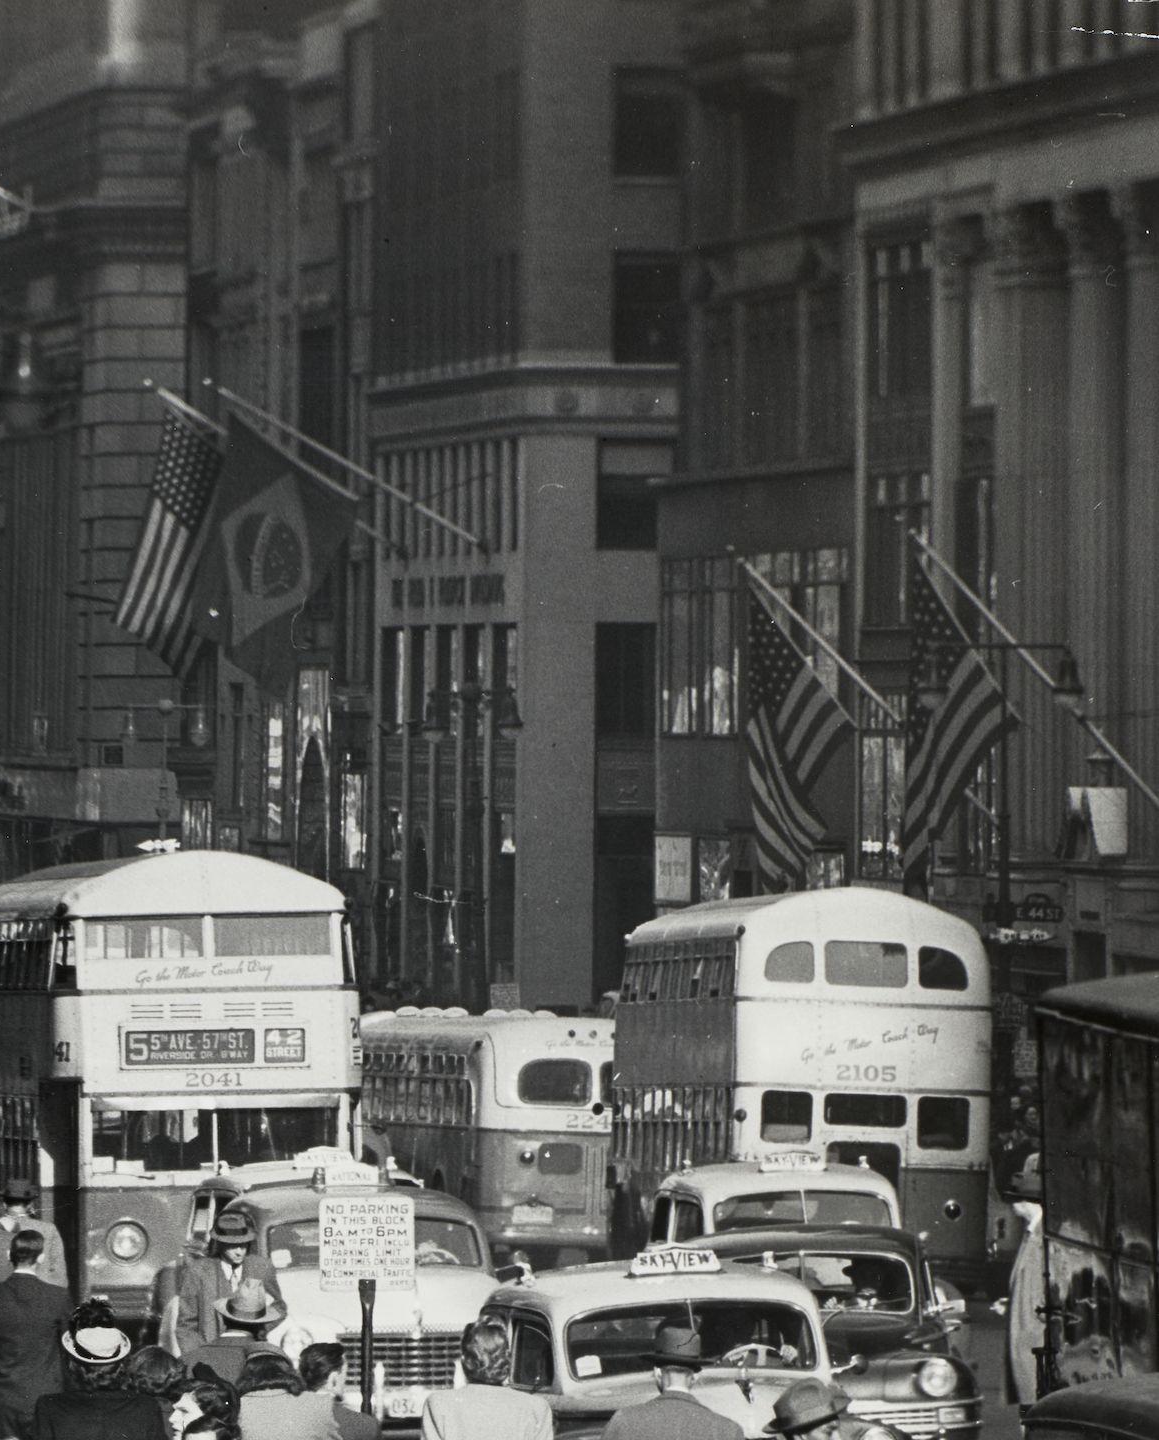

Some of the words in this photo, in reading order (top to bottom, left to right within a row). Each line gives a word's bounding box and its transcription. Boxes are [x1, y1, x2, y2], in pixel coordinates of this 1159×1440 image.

[1028, 907, 1044, 918] 44
[135, 969, 152, 988] Go
[155, 967, 170, 981] the
[172, 965, 207, 979] Motor
[211, 961, 243, 976] Coach
[247, 960, 273, 982] Way
[265, 1029, 303, 1045] 42
[844, 1037, 872, 1052] Motor
[882, 1026, 909, 1045] Coach
[129, 1033, 148, 1061] 5
[265, 1046, 303, 1058] STREET
[150, 1050, 198, 1060] RIVERSIDE
[836, 1064, 897, 1083] 2105
[185, 1072, 243, 1088] 2041
[326, 1204, 344, 1214] NO
[351, 1204, 409, 1214] PARKING
[327, 1216, 337, 1225] IN
[342, 1216, 366, 1225] THIS
[372, 1216, 406, 1225] BLOCK
[323, 1239, 345, 1247] MON
[332, 1249, 369, 1257] PARKING
[376, 1248, 401, 1257] LIMIT
[324, 1258, 347, 1266] OTHER
[374, 1257, 388, 1265] ONE
[390, 1257, 410, 1265] HOUR
